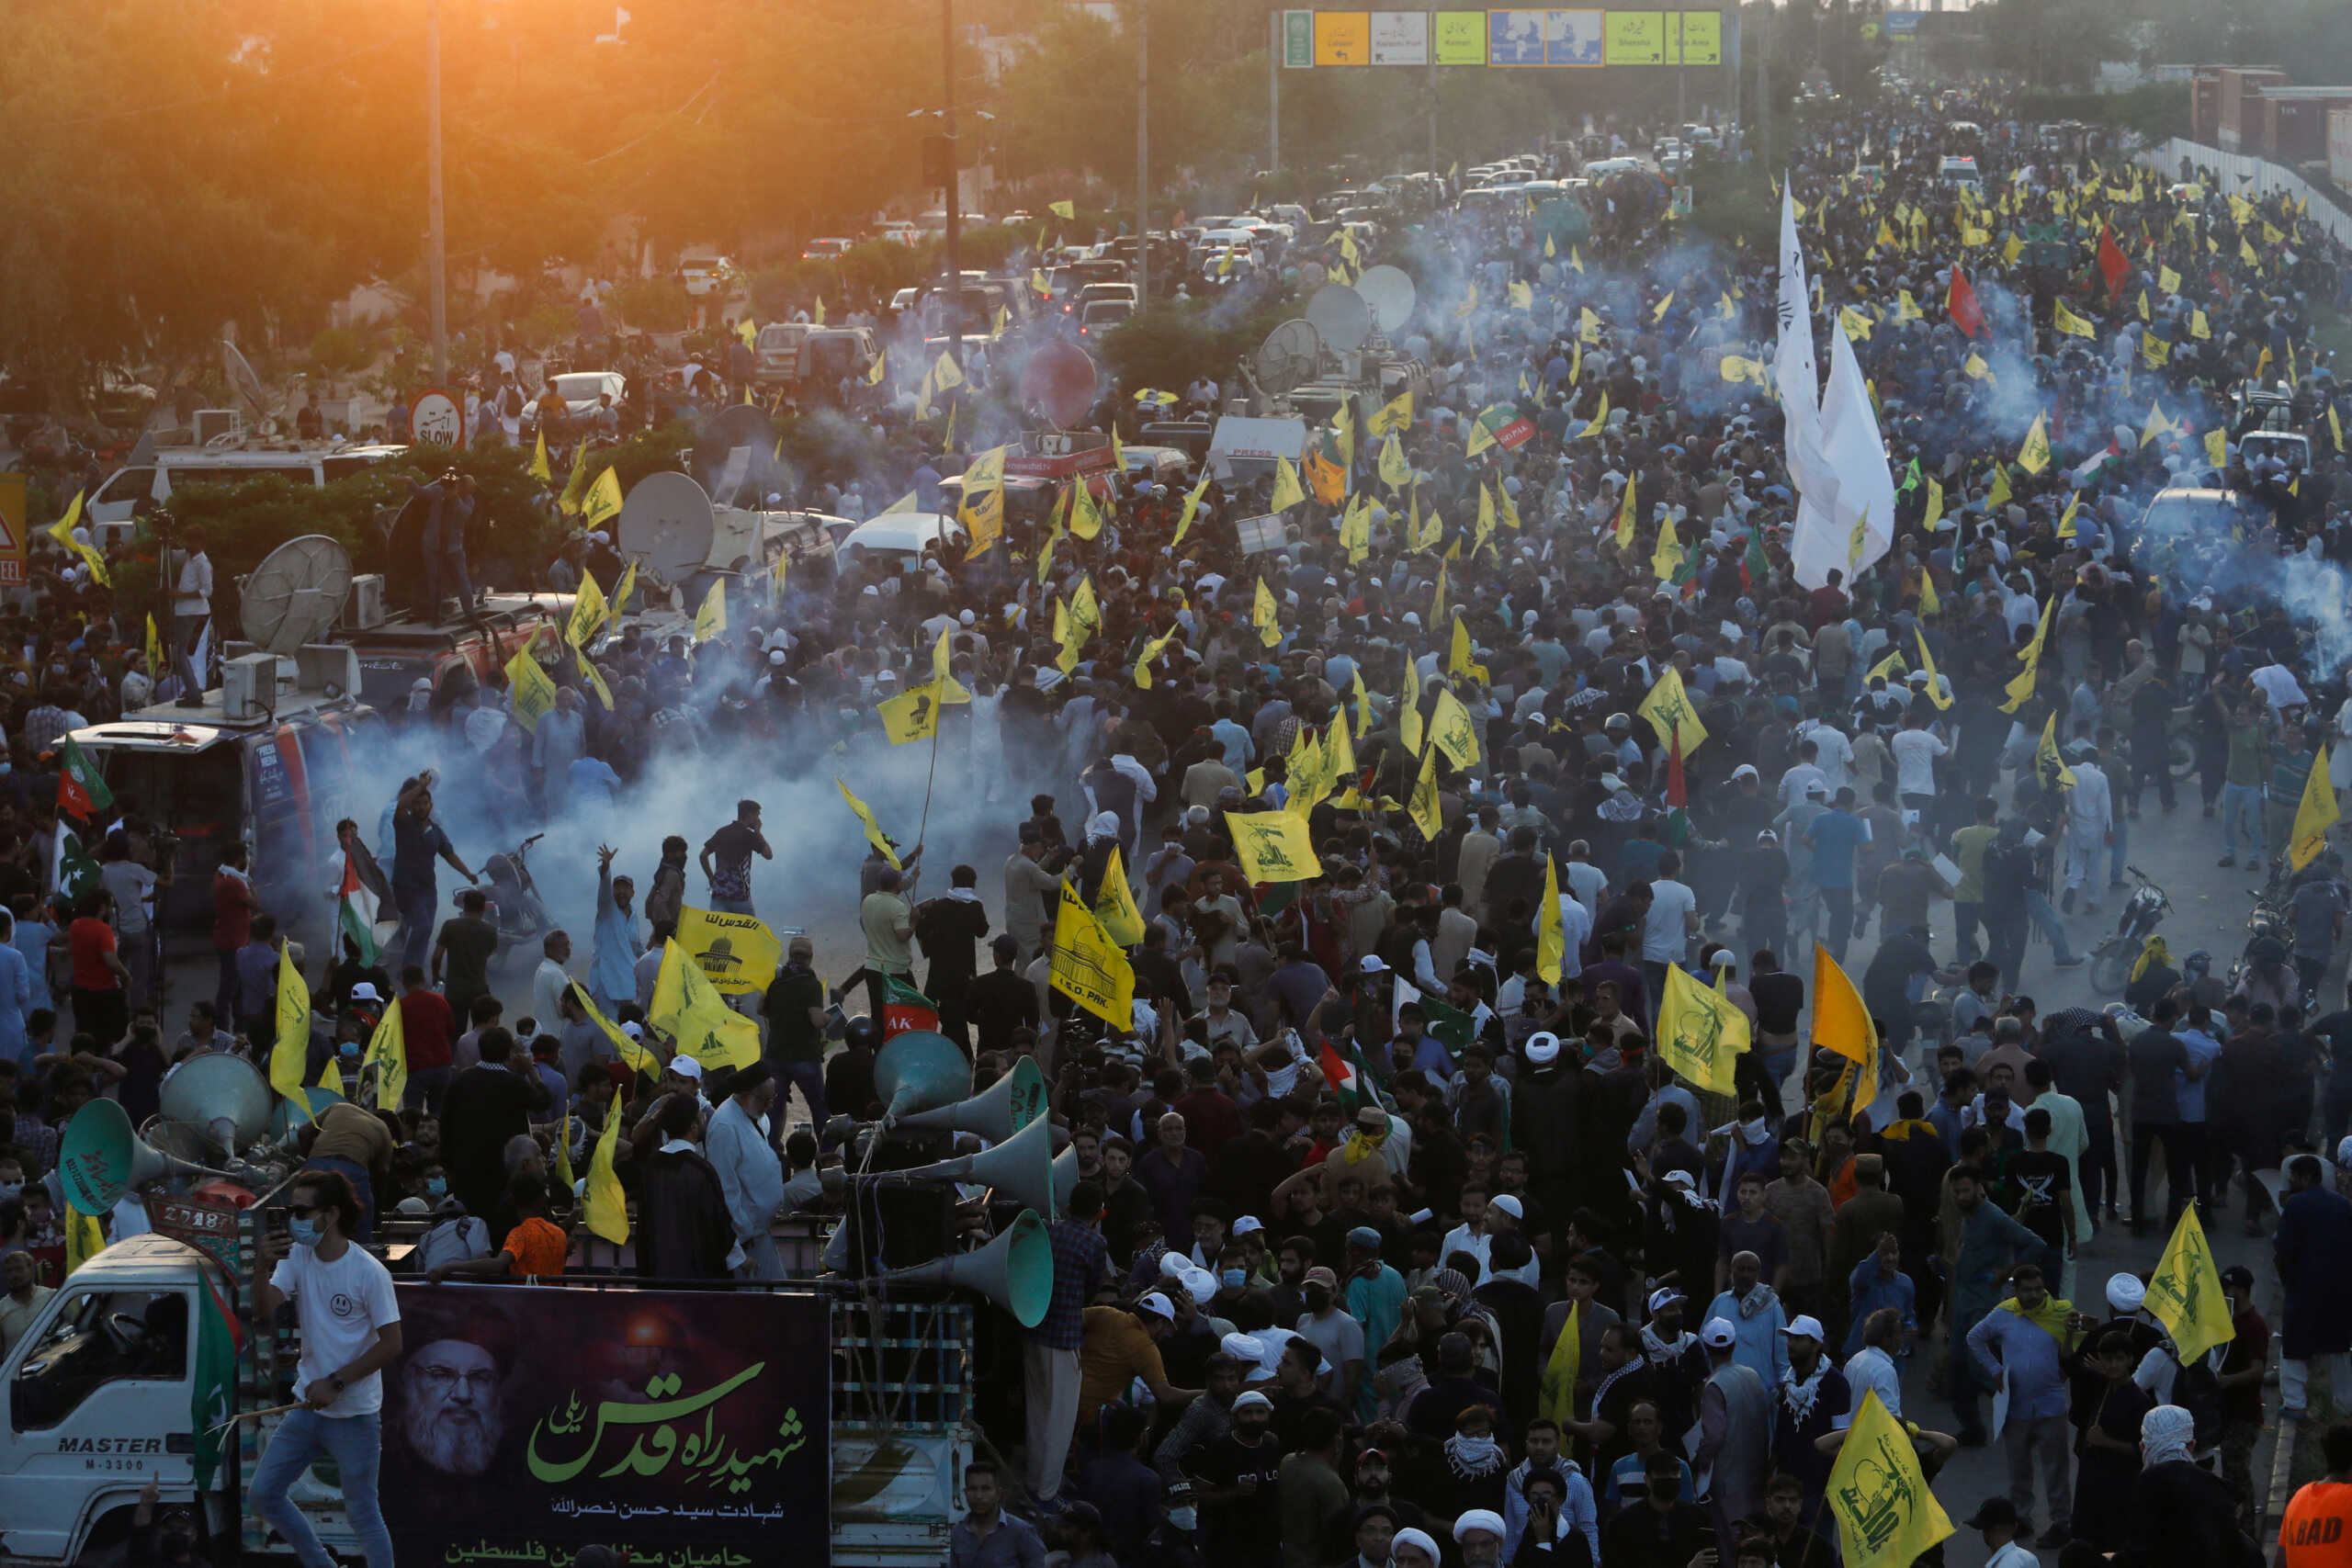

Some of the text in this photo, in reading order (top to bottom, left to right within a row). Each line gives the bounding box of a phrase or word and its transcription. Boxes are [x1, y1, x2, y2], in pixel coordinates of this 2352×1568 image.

[420, 430, 454, 446] SLOW
[1233, 448, 1272, 457] PRESS
[58, 1438, 162, 1453] MASTER
[618, 1502, 670, 1519] حسن
[445, 1538, 547, 1563] فلسطین
